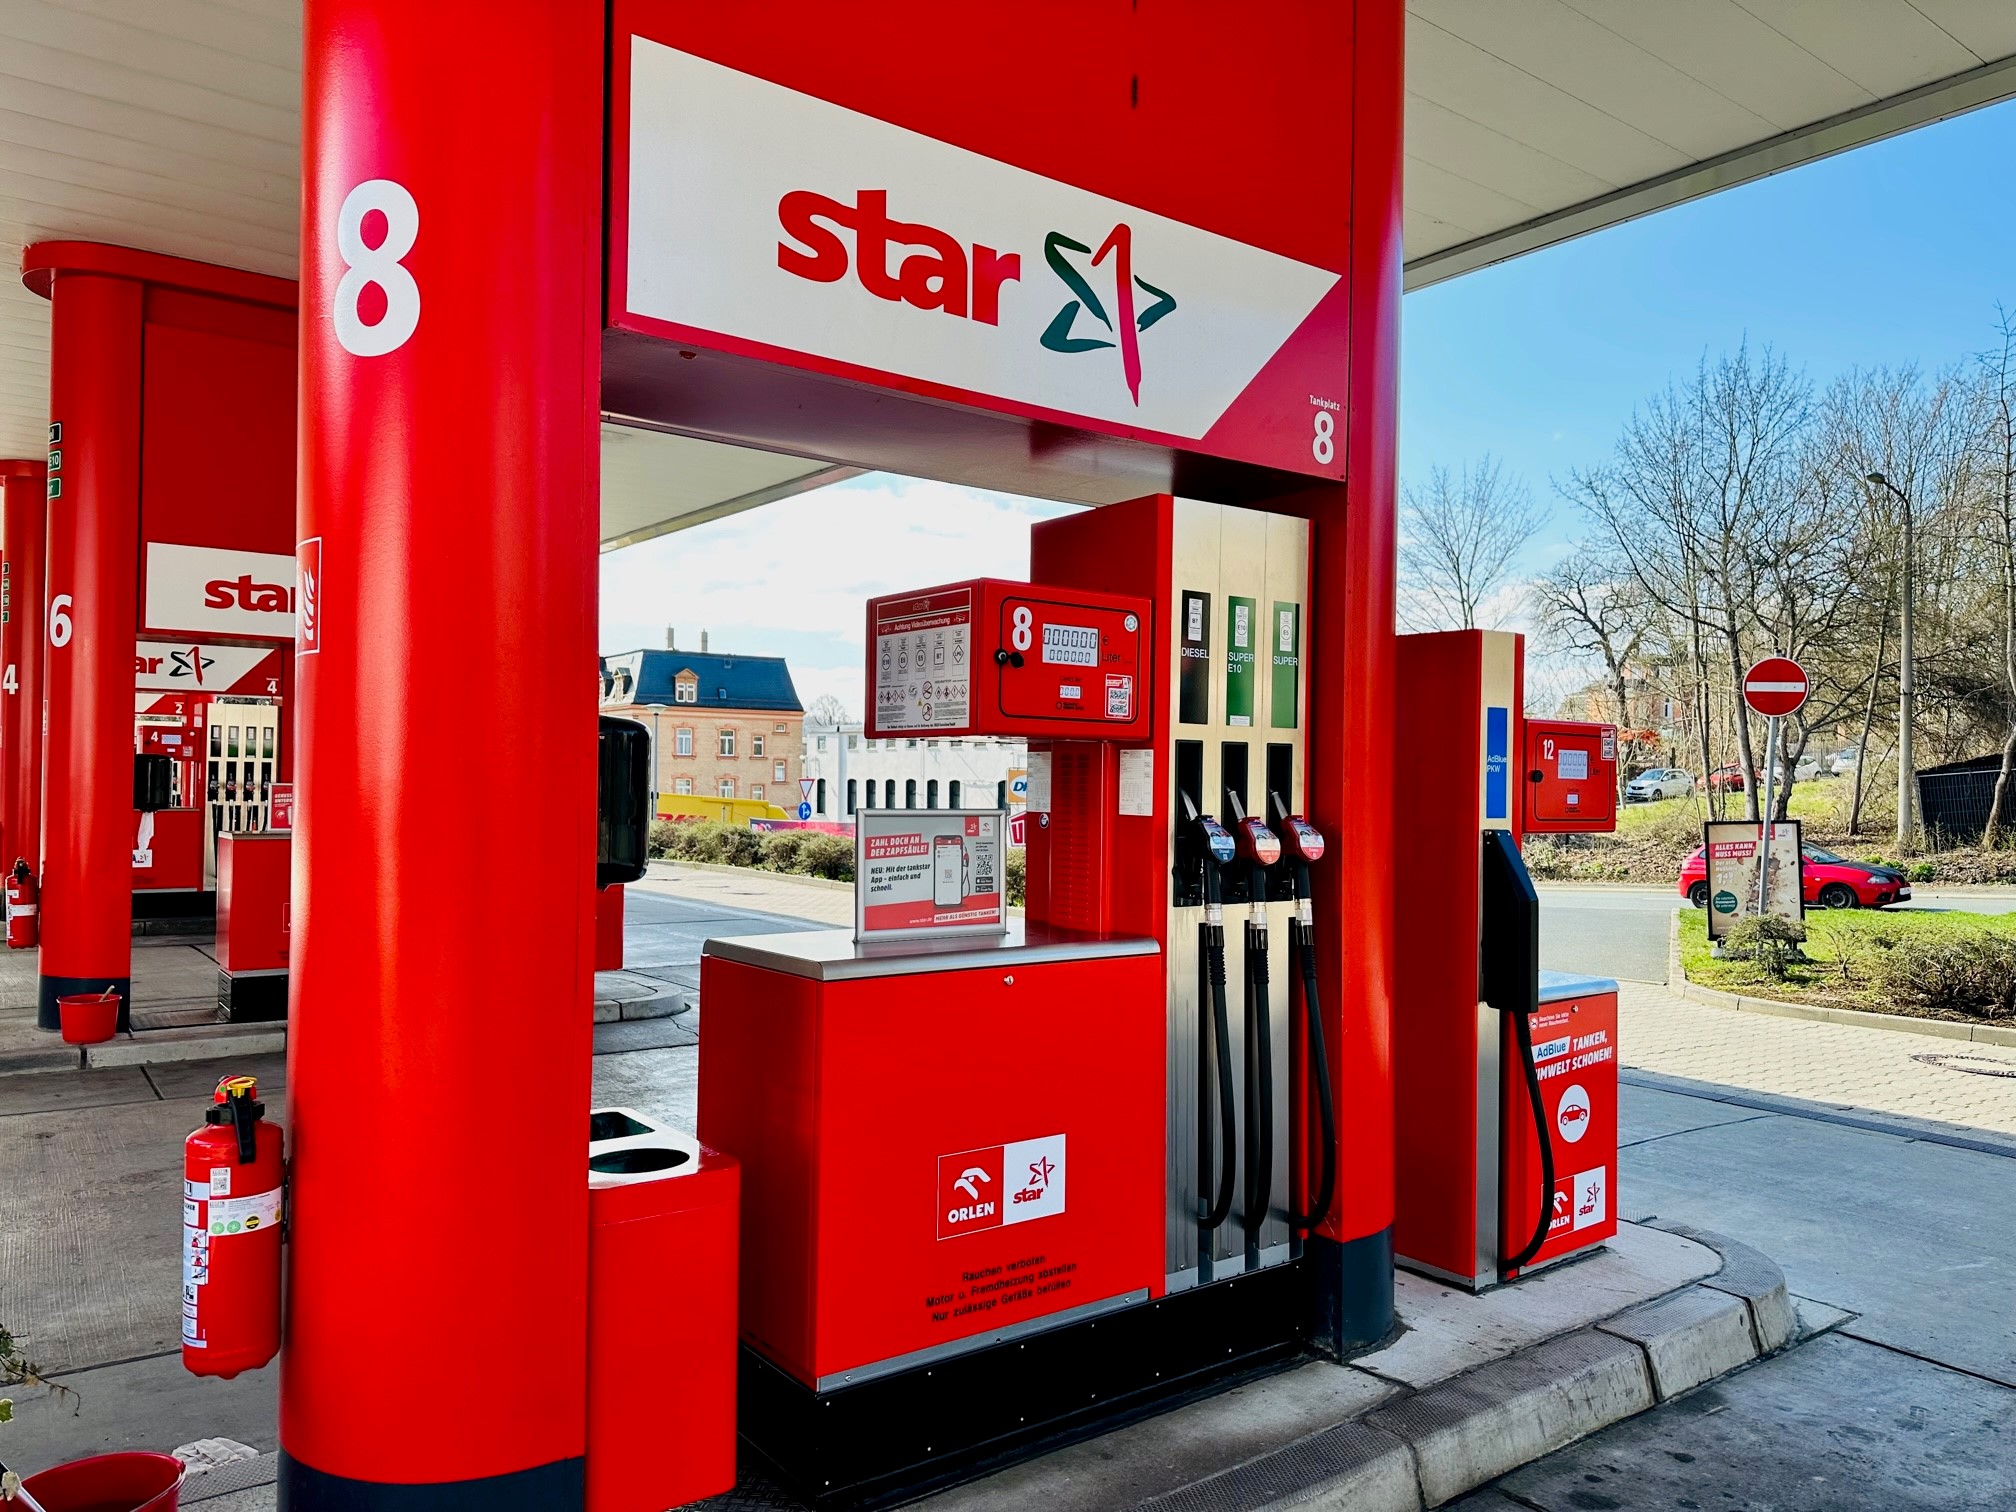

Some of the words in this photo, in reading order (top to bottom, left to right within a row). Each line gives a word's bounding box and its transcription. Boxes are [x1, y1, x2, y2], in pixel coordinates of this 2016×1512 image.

[777, 189, 1020, 327] star
[334, 179, 420, 357] 8
[1309, 394, 1340, 411] Tankplatz
[1312, 410, 1334, 465] 8
[50, 594, 72, 647] 6
[894, 622, 911, 631] Achtung
[911, 617, 951, 628] Videoüberwachung
[1012, 606, 1032, 651] 8
[1102, 635, 1109, 646] €
[1101, 652, 1121, 663] Liter
[1181, 647, 1209, 659] DIESEL
[1228, 652, 1254, 662] SUPER
[1228, 663, 1242, 673] E10
[1273, 656, 1298, 666] SUPER
[2, 664, 19, 695] 4
[266, 680, 277, 694] 4
[175, 704, 183, 714] 2
[151, 731, 159, 742] 4
[1543, 739, 1554, 760] 12
[1487, 755, 1507, 763] AdBlue
[1487, 765, 1500, 773] PKW
[871, 837, 888, 847] ZAHL
[890, 836, 909, 845] DOCH
[910, 835, 920, 844] AN
[871, 847, 886, 857] DER
[886, 844, 928, 856] ZAPFSÄULE!
[871, 866, 884, 875] NEU:
[886, 865, 895, 873] Mit
[896, 864, 906, 872] der
[907, 863, 930, 871] tankstar
[871, 876, 883, 884] App
[888, 873, 909, 882] einfach
[910, 872, 921, 880] und
[871, 884, 893, 892] schnell.
[1537, 1042, 1566, 1059] AdBlue
[1573, 1030, 1608, 1052] TANKEN,
[1572, 1046, 1612, 1071] SCHONEN!
[1013, 1186, 1043, 1204] star
[948, 1201, 995, 1224] ORLEN
[1579, 1204, 1594, 1216] star
[962, 1266, 1002, 1282] Rauchen
[1006, 1255, 1045, 1270] verboten
[926, 1293, 954, 1308] Motor
[971, 1273, 1034, 1295] Fremdheizung
[1038, 1262, 1077, 1279] abstellen
[932, 1311, 948, 1322] Nur
[953, 1298, 997, 1317] zulässige
[1001, 1288, 1033, 1304] Gefäße
[1037, 1279, 1071, 1294] befüllen
